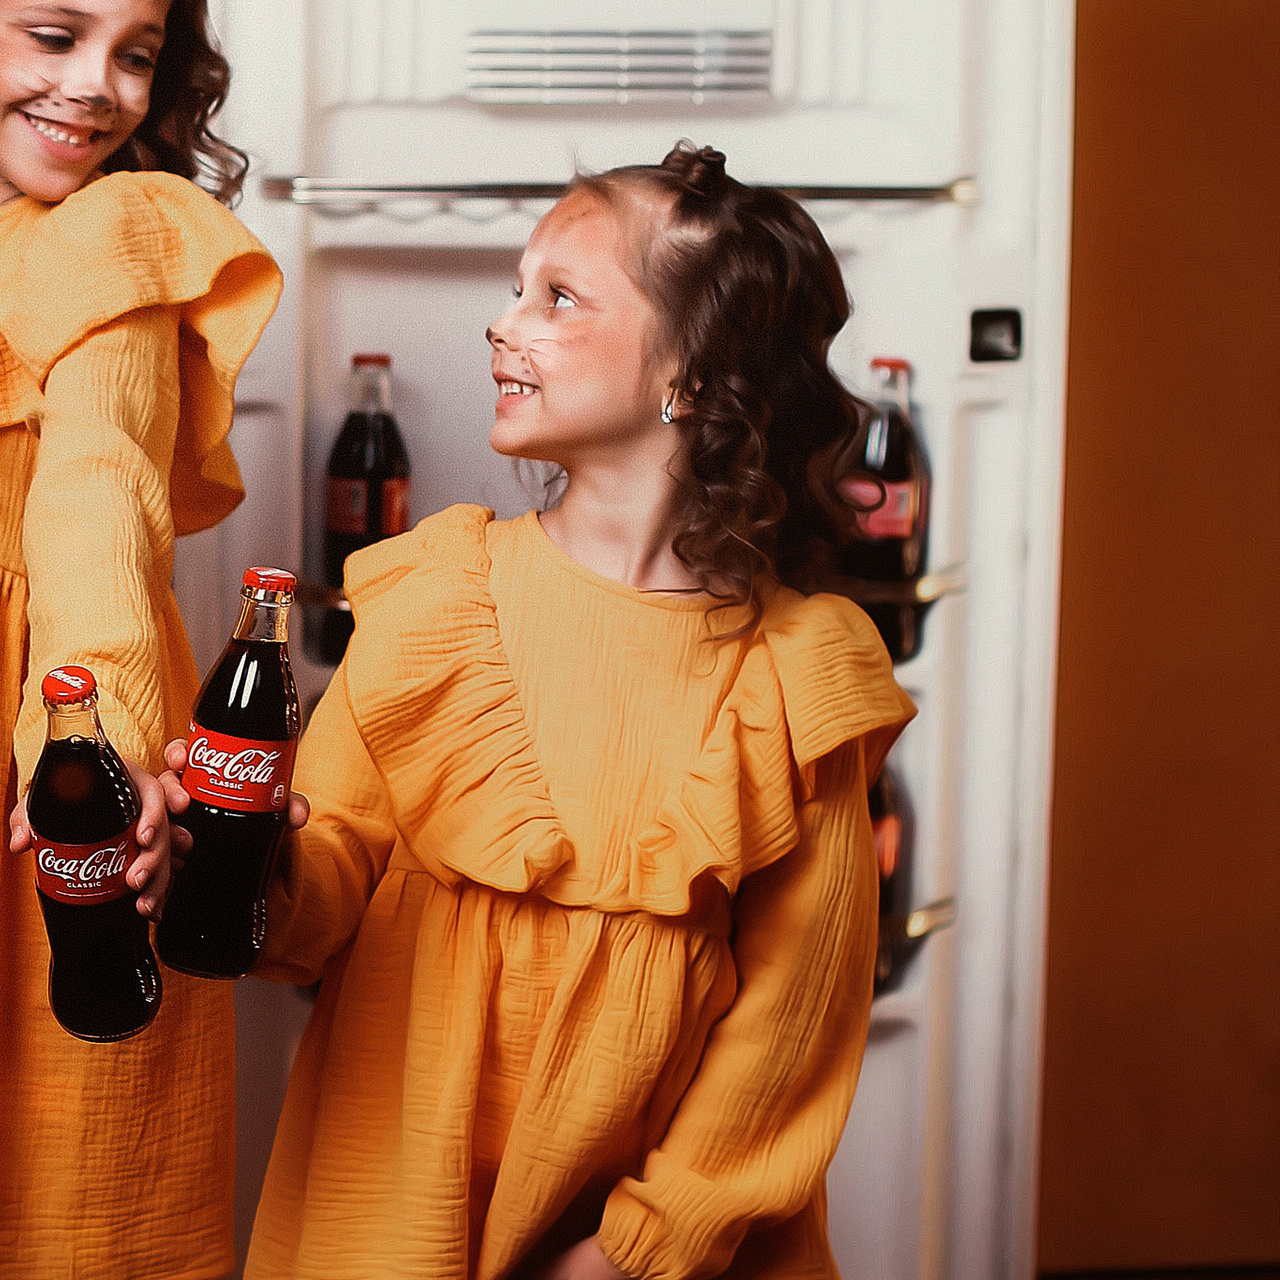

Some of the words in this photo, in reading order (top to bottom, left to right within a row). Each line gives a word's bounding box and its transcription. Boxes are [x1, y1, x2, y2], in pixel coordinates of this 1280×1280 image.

[188, 737, 282, 783] Coca-Cola
[208, 777, 244, 790] CLASSIC
[38, 839, 129, 881] Coca-Cola
[66, 881, 102, 889] CLASSIC
